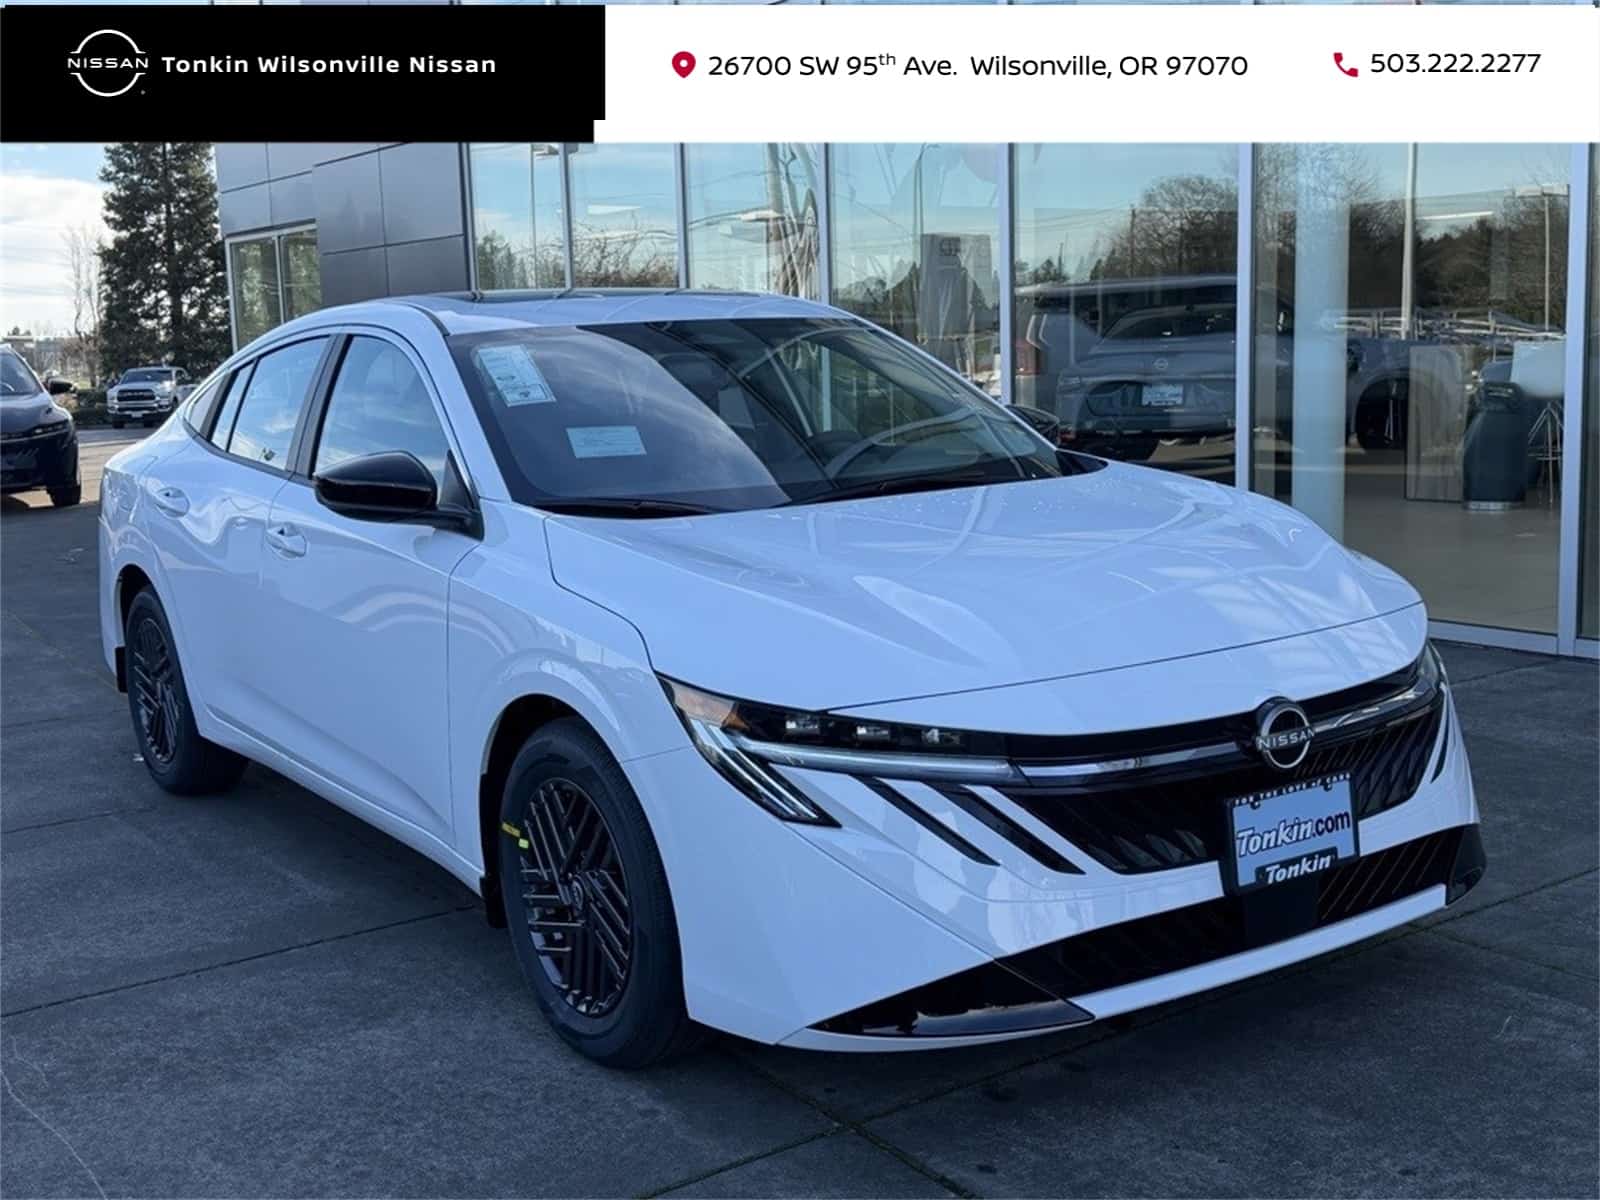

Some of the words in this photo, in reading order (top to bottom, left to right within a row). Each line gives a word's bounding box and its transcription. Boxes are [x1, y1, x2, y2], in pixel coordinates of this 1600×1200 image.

[1256, 727, 1316, 750] NISSAN
[1236, 810, 1351, 858] Tonkin.com
[1265, 853, 1331, 885] Tonkin
